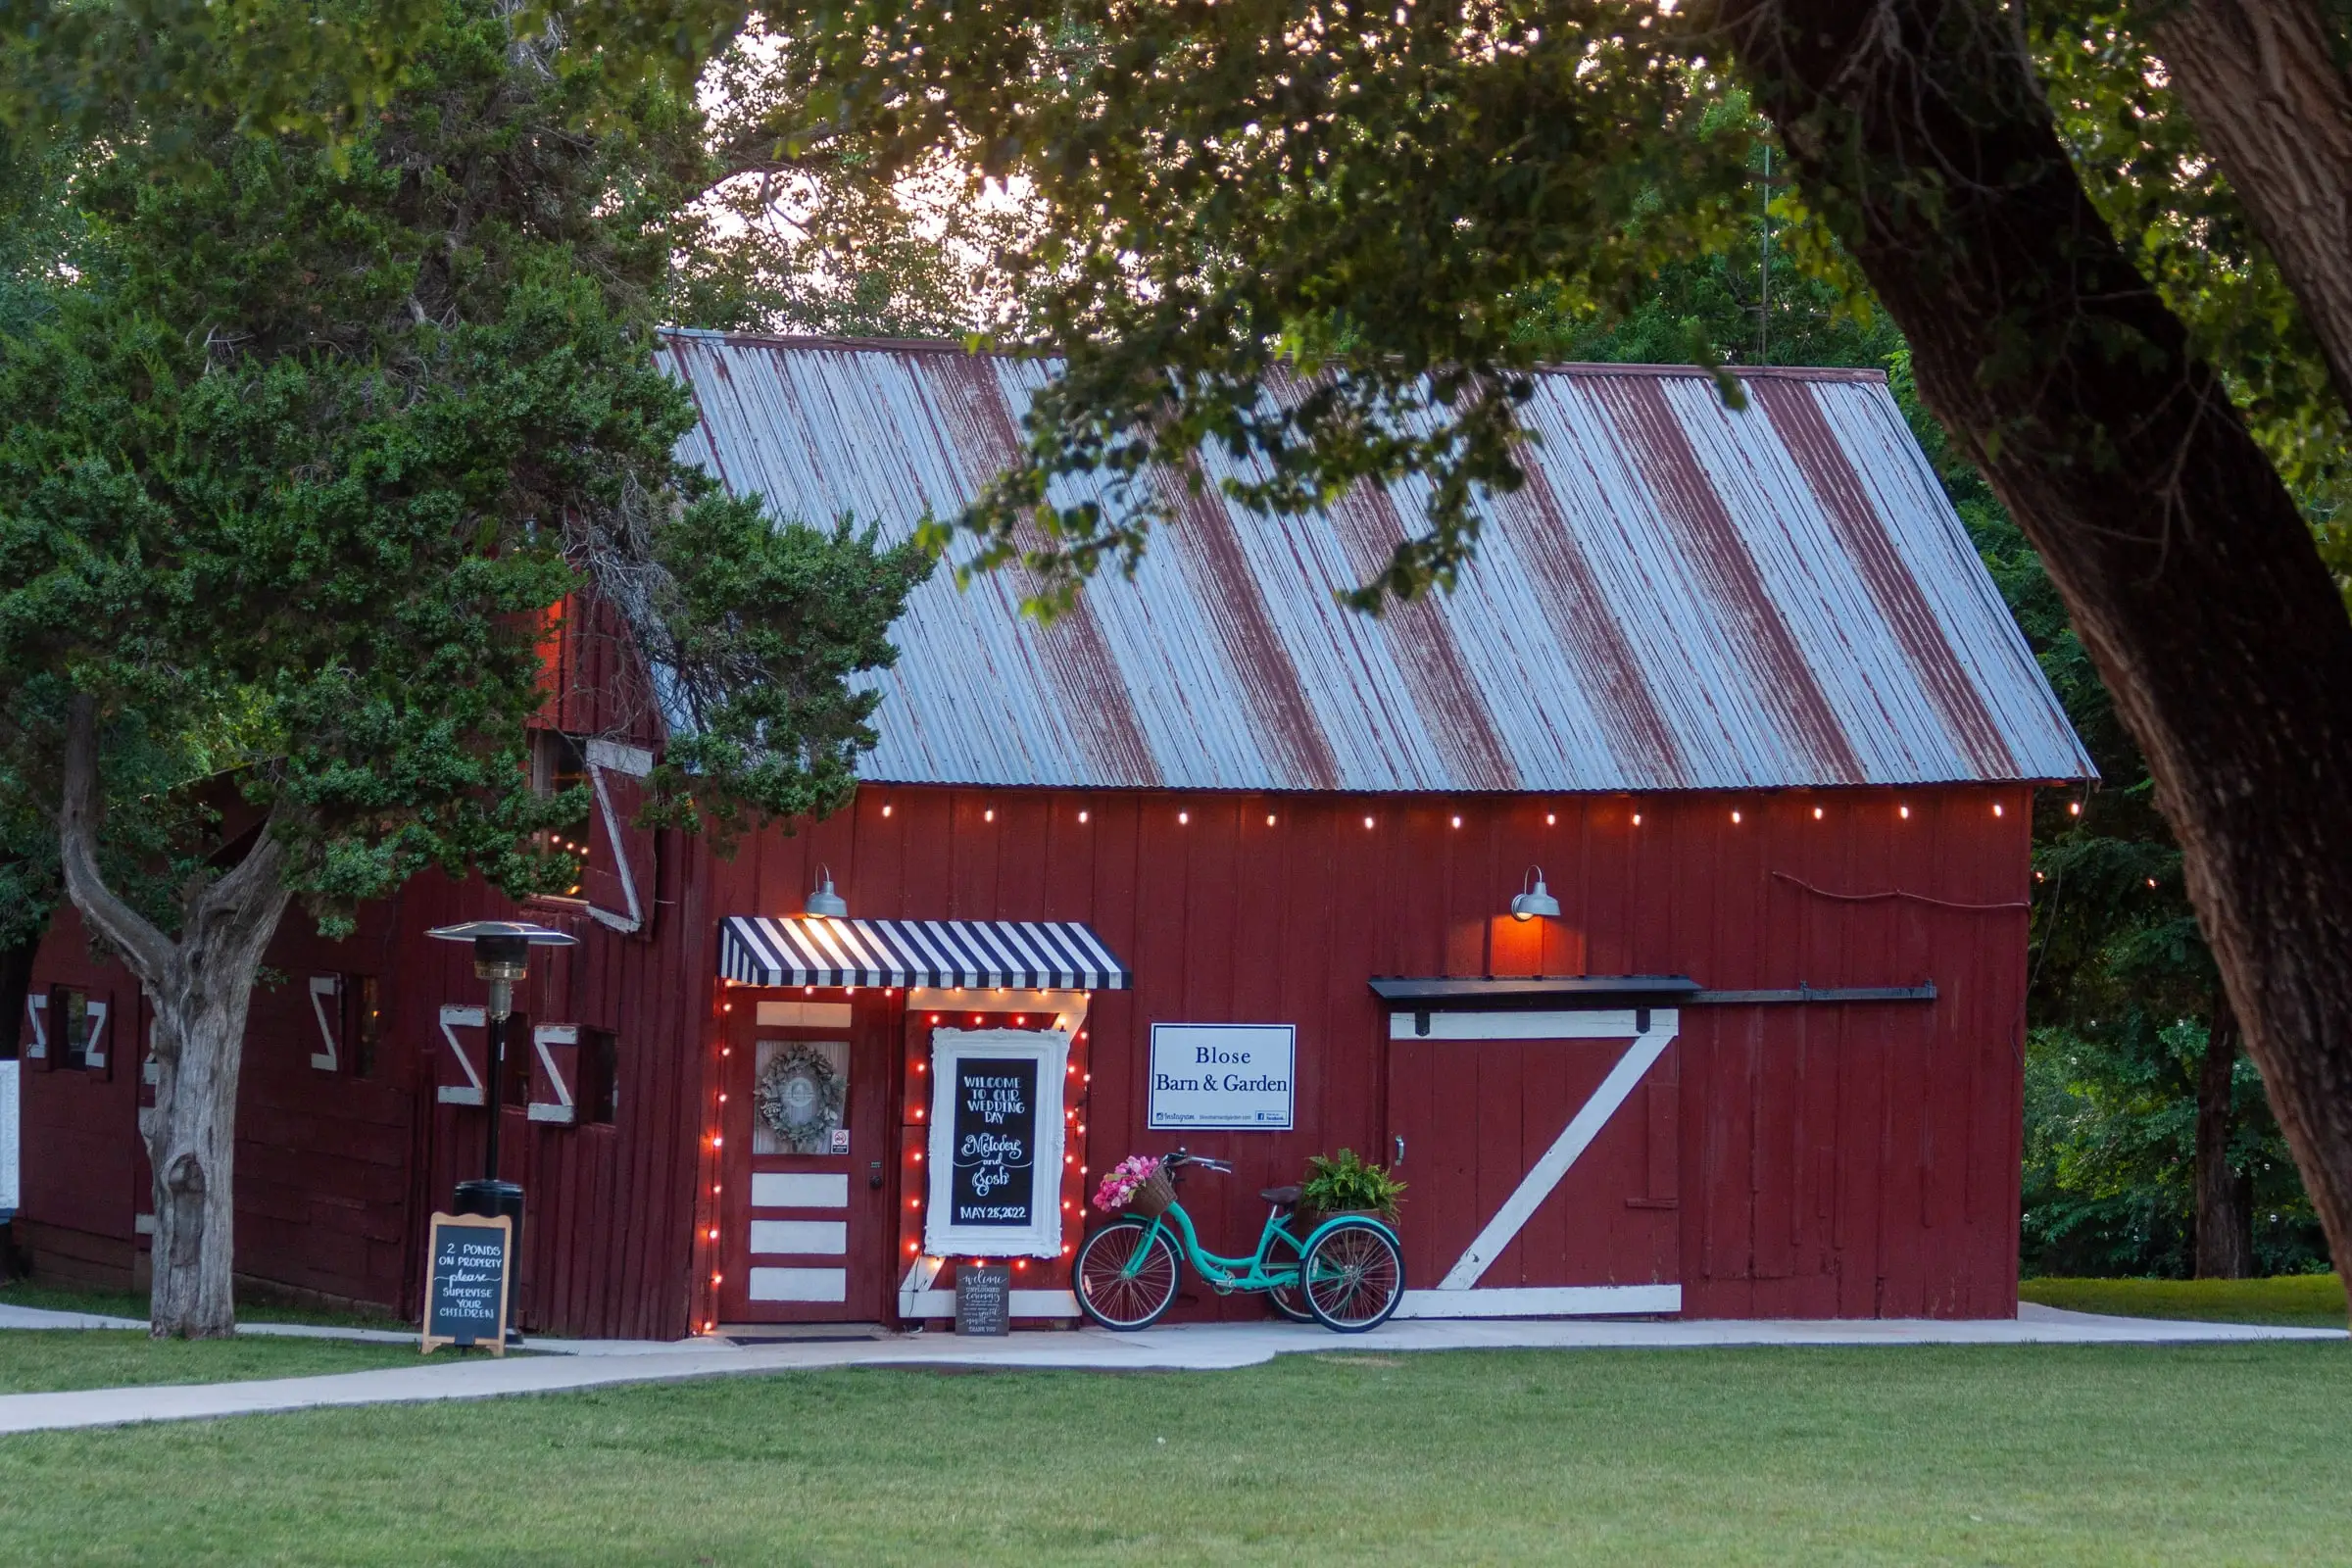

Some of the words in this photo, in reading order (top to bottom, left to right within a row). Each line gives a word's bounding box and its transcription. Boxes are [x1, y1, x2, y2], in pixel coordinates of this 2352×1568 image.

[1196, 1047, 1251, 1063] Blose
[963, 1076, 1021, 1089] WELCOME
[1155, 1073, 1200, 1092] Barn
[1202, 1074, 1218, 1092] &
[1223, 1074, 1288, 1092] Garden
[972, 1089, 987, 1100] TO
[993, 1089, 1020, 1102] OUR
[966, 1100, 1025, 1114] WEDDING
[985, 1111, 1004, 1124] DAY
[982, 1152, 1003, 1165] and
[972, 1166, 1009, 1197] Josh
[960, 1206, 987, 1219] MAY
[447, 1243, 456, 1254] 2
[463, 1244, 501, 1256] PONDS
[438, 1256, 455, 1266] ON
[458, 1256, 503, 1268] PROPERTY
[447, 1268, 490, 1289] please
[963, 1269, 1002, 1285] welcome
[442, 1287, 494, 1298] SUPERVISE
[457, 1298, 482, 1309] YOUR
[439, 1307, 495, 1319] CHILDREN
